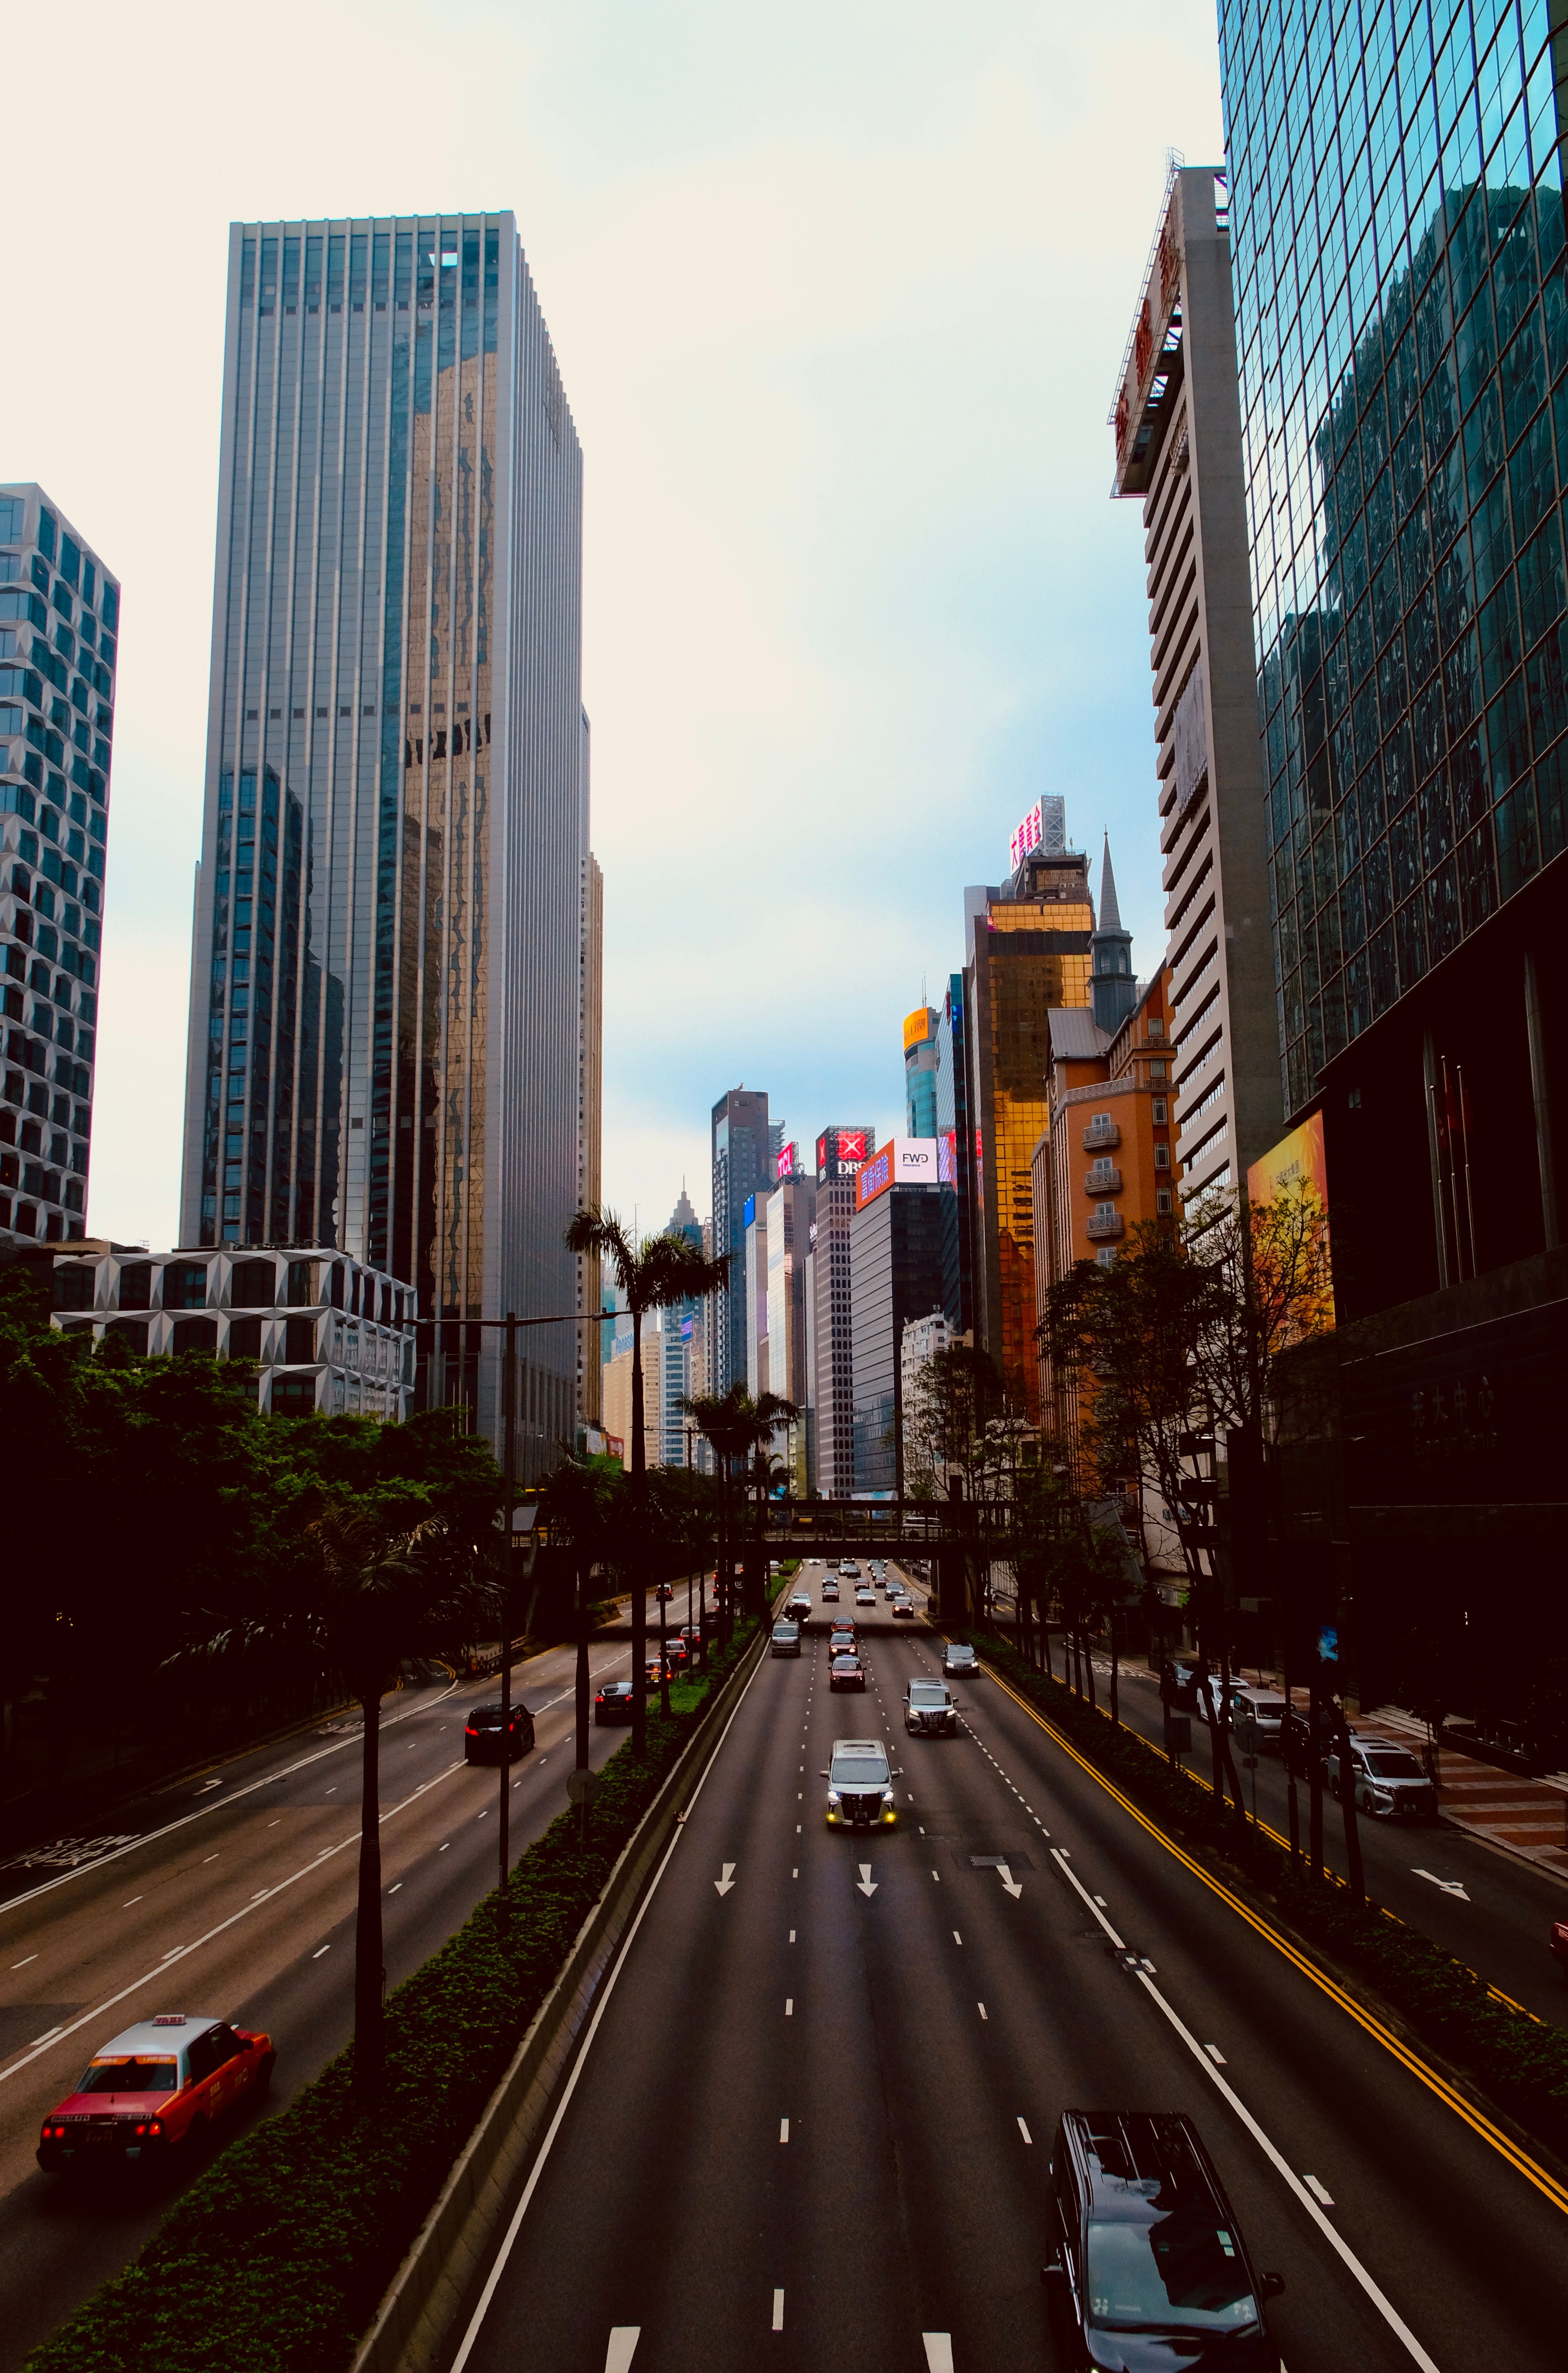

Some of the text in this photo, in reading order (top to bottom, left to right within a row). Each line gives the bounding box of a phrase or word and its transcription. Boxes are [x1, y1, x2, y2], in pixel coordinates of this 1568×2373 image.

[778, 1149, 792, 1178] TCL
[903, 1153, 929, 1163] FWD
[1410, 1375, 1495, 1429] 光大中心
[44, 1834, 141, 1849] SLOW
